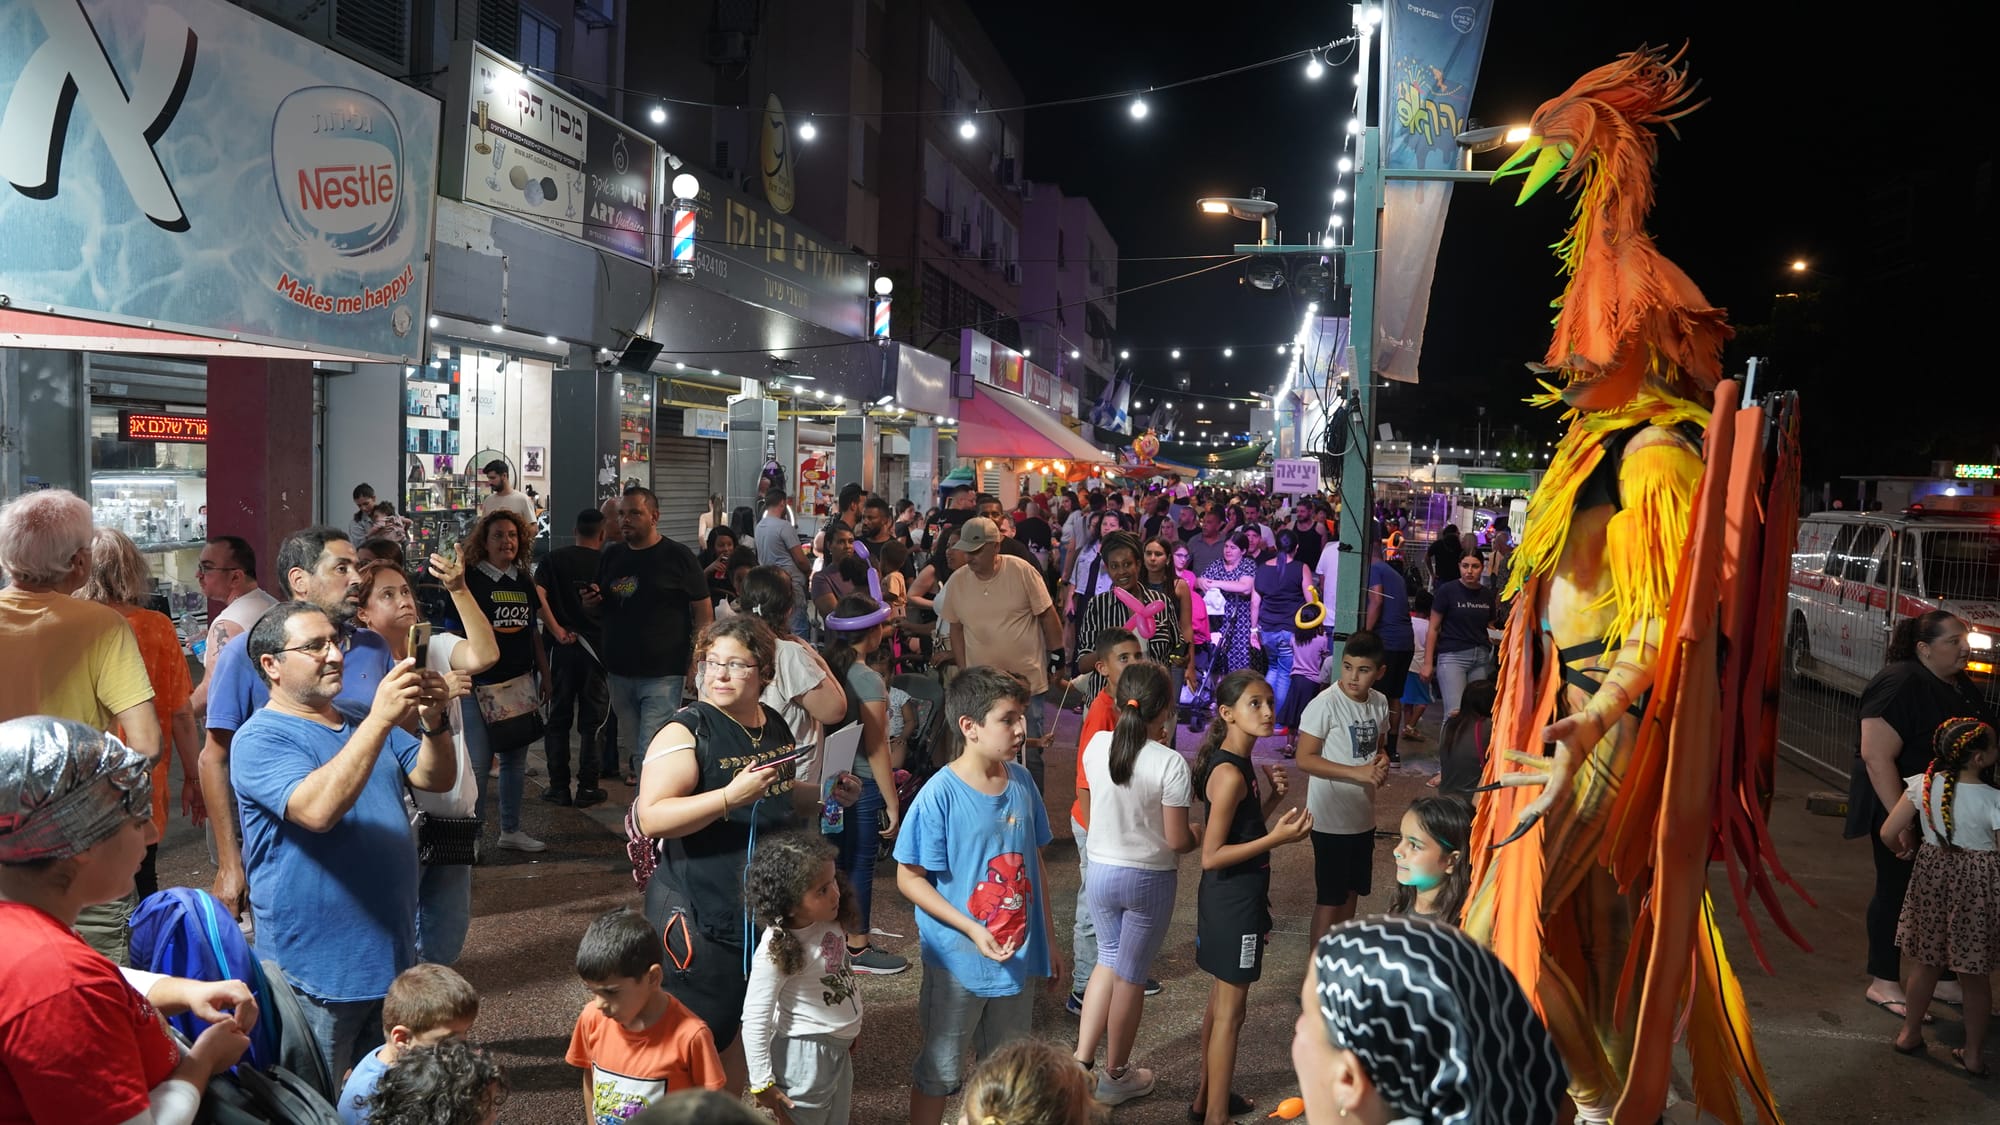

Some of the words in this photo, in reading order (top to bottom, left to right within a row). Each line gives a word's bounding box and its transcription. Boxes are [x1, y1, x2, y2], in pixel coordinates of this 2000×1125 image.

[551, 104, 584, 142] מכון
[298, 163, 394, 211] Nestlé
[590, 201, 616, 225] ART
[277, 273, 334, 313] Makes
[337, 298, 362, 313] me
[365, 263, 415, 310] happy!
[148, 417, 182, 434] שלכם
[1276, 464, 1316, 479] יציאה
[494, 606, 529, 620] 100%
